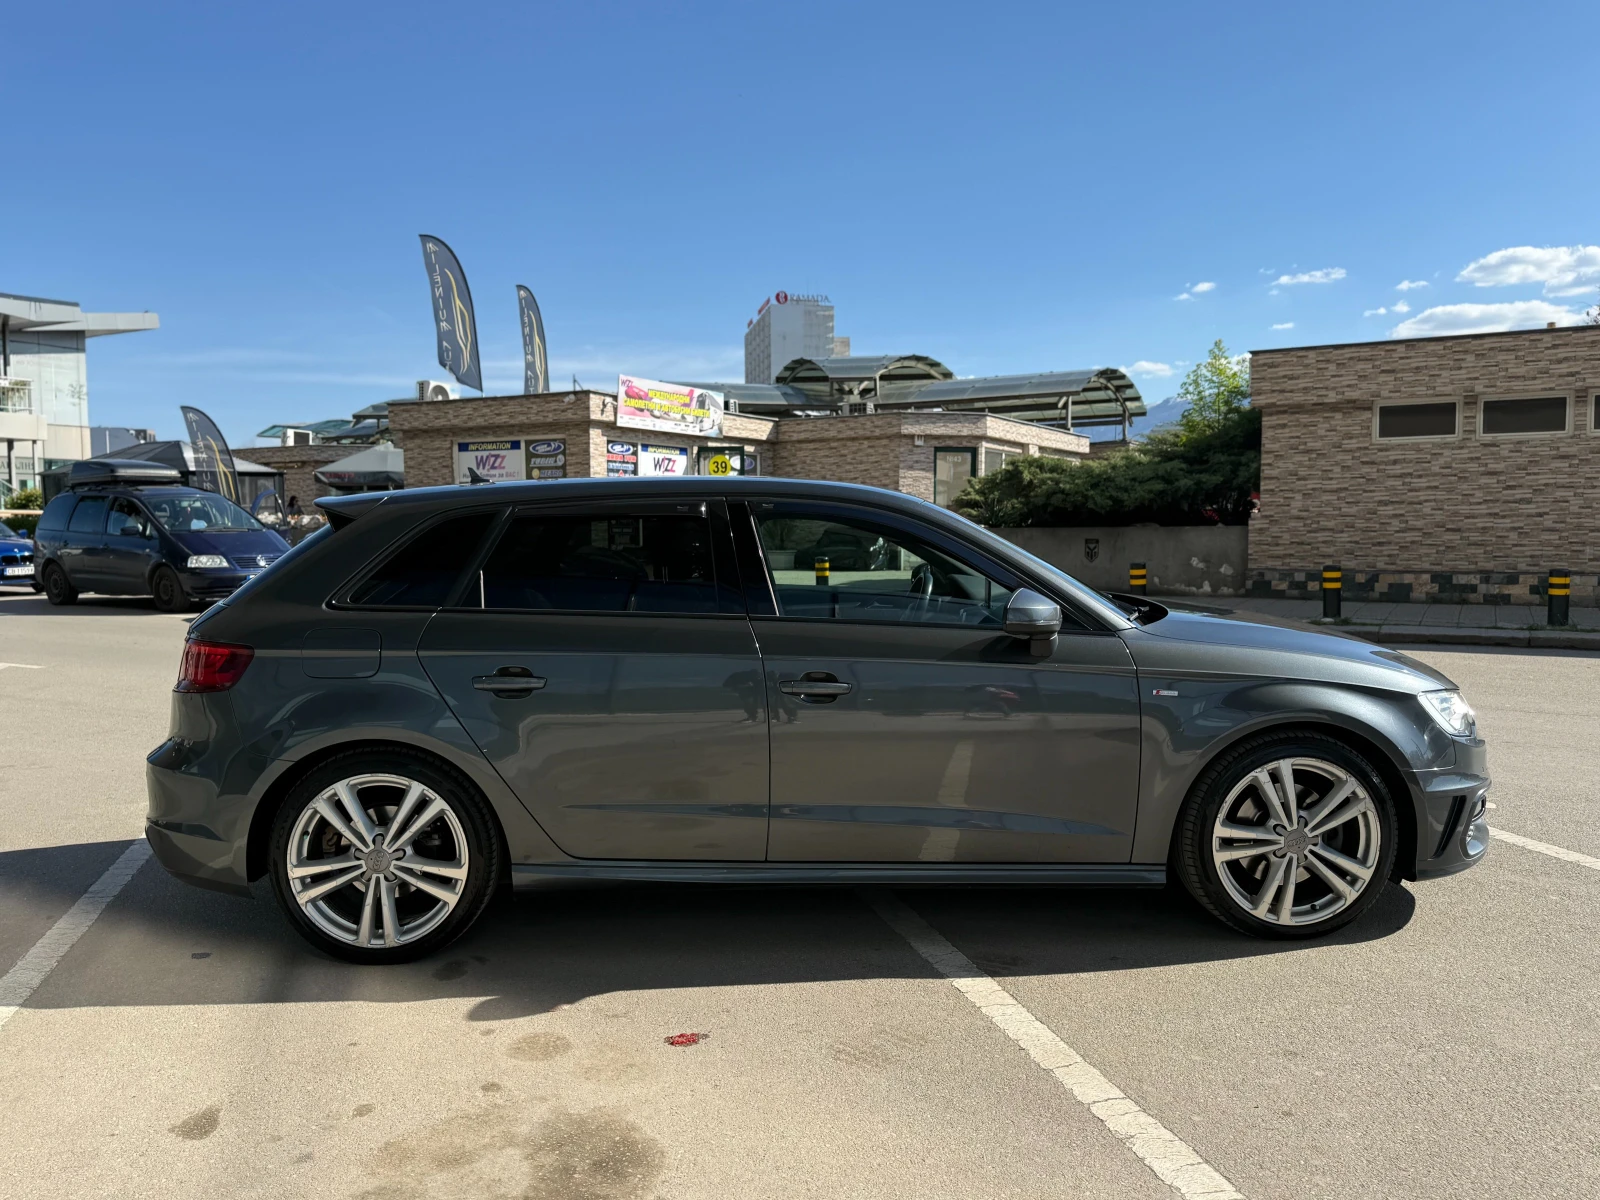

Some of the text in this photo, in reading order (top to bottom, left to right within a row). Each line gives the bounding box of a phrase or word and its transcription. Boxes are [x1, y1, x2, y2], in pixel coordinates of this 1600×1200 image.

[789, 293, 831, 303] RAMADA
[468, 442, 511, 451] INFORMATION
[648, 446, 680, 455] INFORMATION
[712, 461, 728, 473] 39
